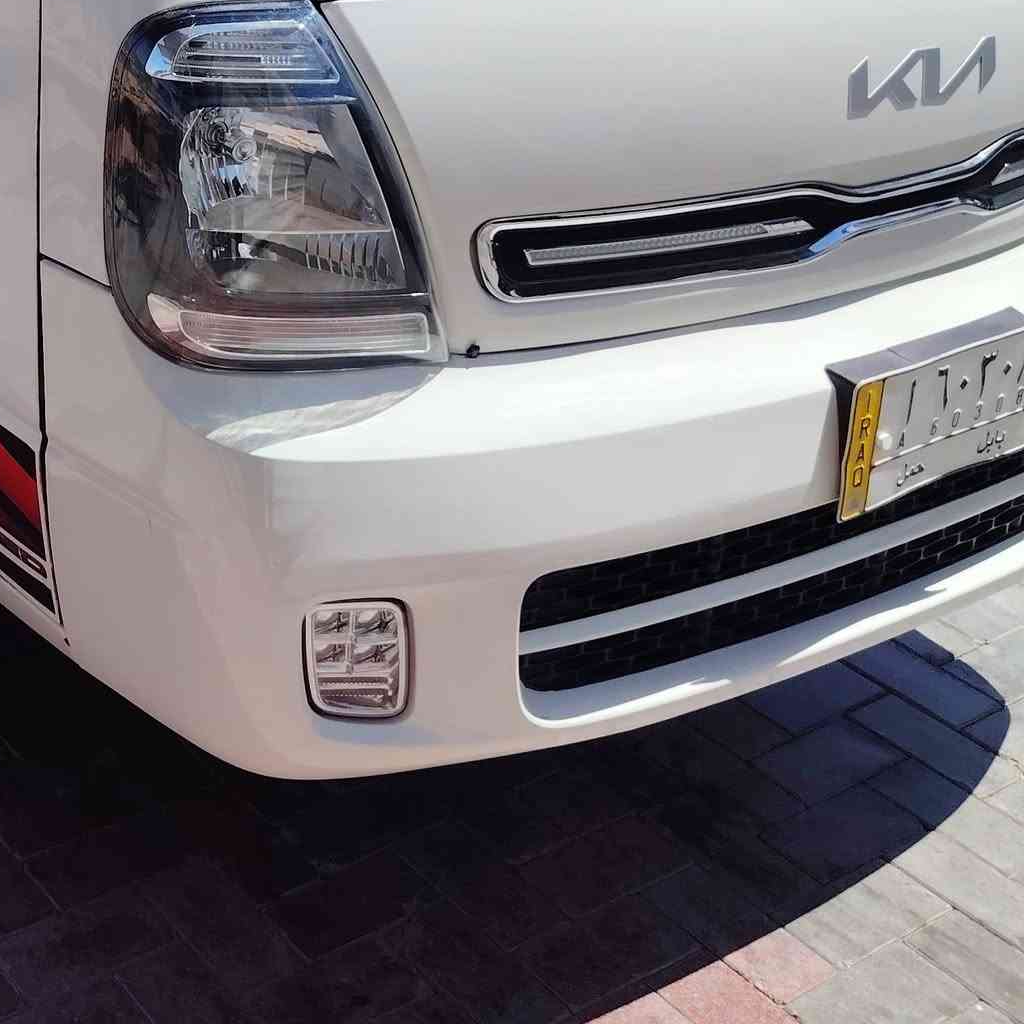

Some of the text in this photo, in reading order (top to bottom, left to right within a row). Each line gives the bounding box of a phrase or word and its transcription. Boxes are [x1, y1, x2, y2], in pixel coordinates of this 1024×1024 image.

[846, 35, 996, 120] KIA
[851, 392, 872, 488] IRAQ
[976, 429, 1006, 454] بابل
